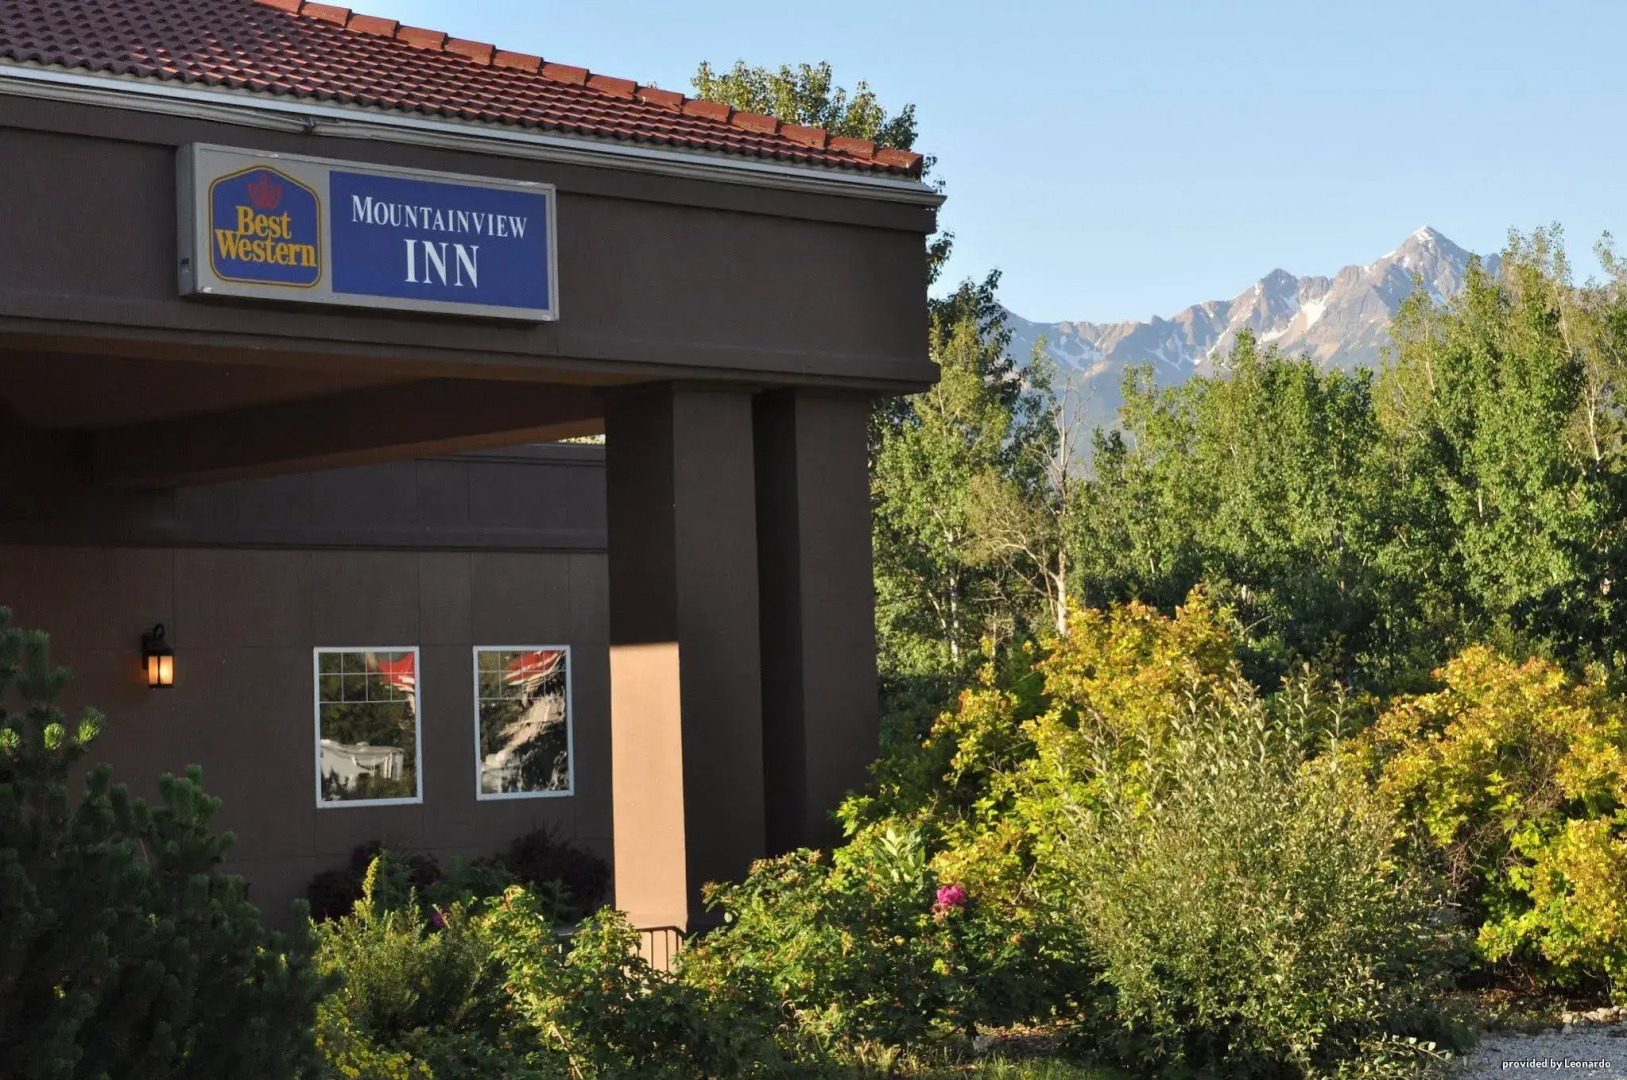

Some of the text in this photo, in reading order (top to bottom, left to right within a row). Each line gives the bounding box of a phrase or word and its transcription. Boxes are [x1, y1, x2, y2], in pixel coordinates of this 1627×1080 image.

[235, 205, 292, 239] Best
[351, 194, 528, 239] MOUNTAINVIEW
[215, 229, 317, 268] Western
[403, 239, 480, 289] INN
